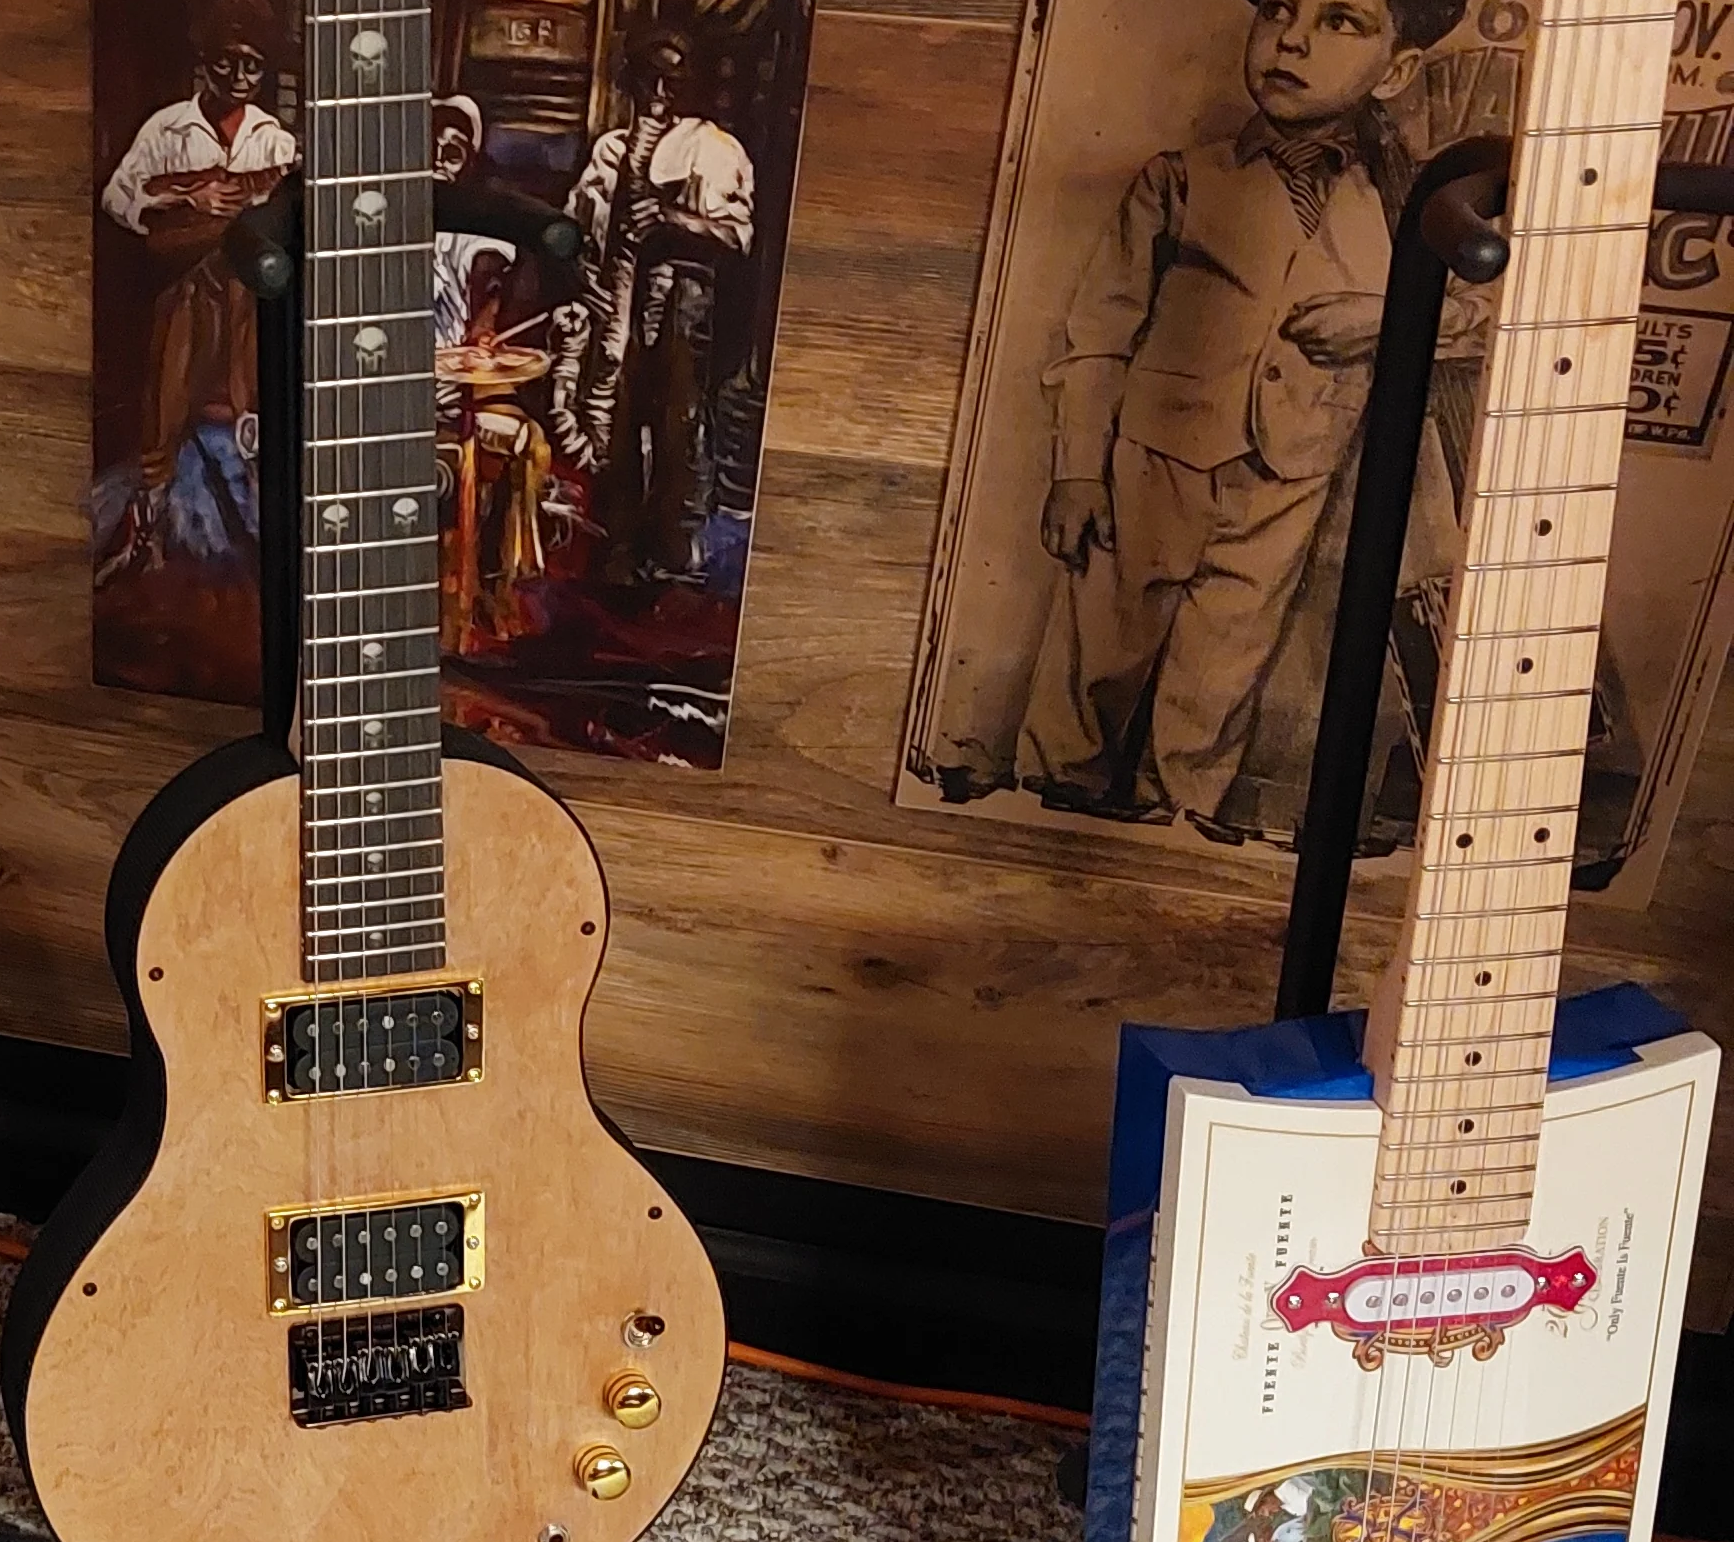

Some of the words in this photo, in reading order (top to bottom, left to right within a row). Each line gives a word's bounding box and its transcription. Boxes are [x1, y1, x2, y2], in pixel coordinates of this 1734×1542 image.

[1637, 319, 1693, 339] ULTS
[1632, 339, 1688, 370] 5¢
[1630, 368, 1682, 387] DREN
[1625, 385, 1682, 417] 0¢
[1275, 1194, 1294, 1268] FUENTE
